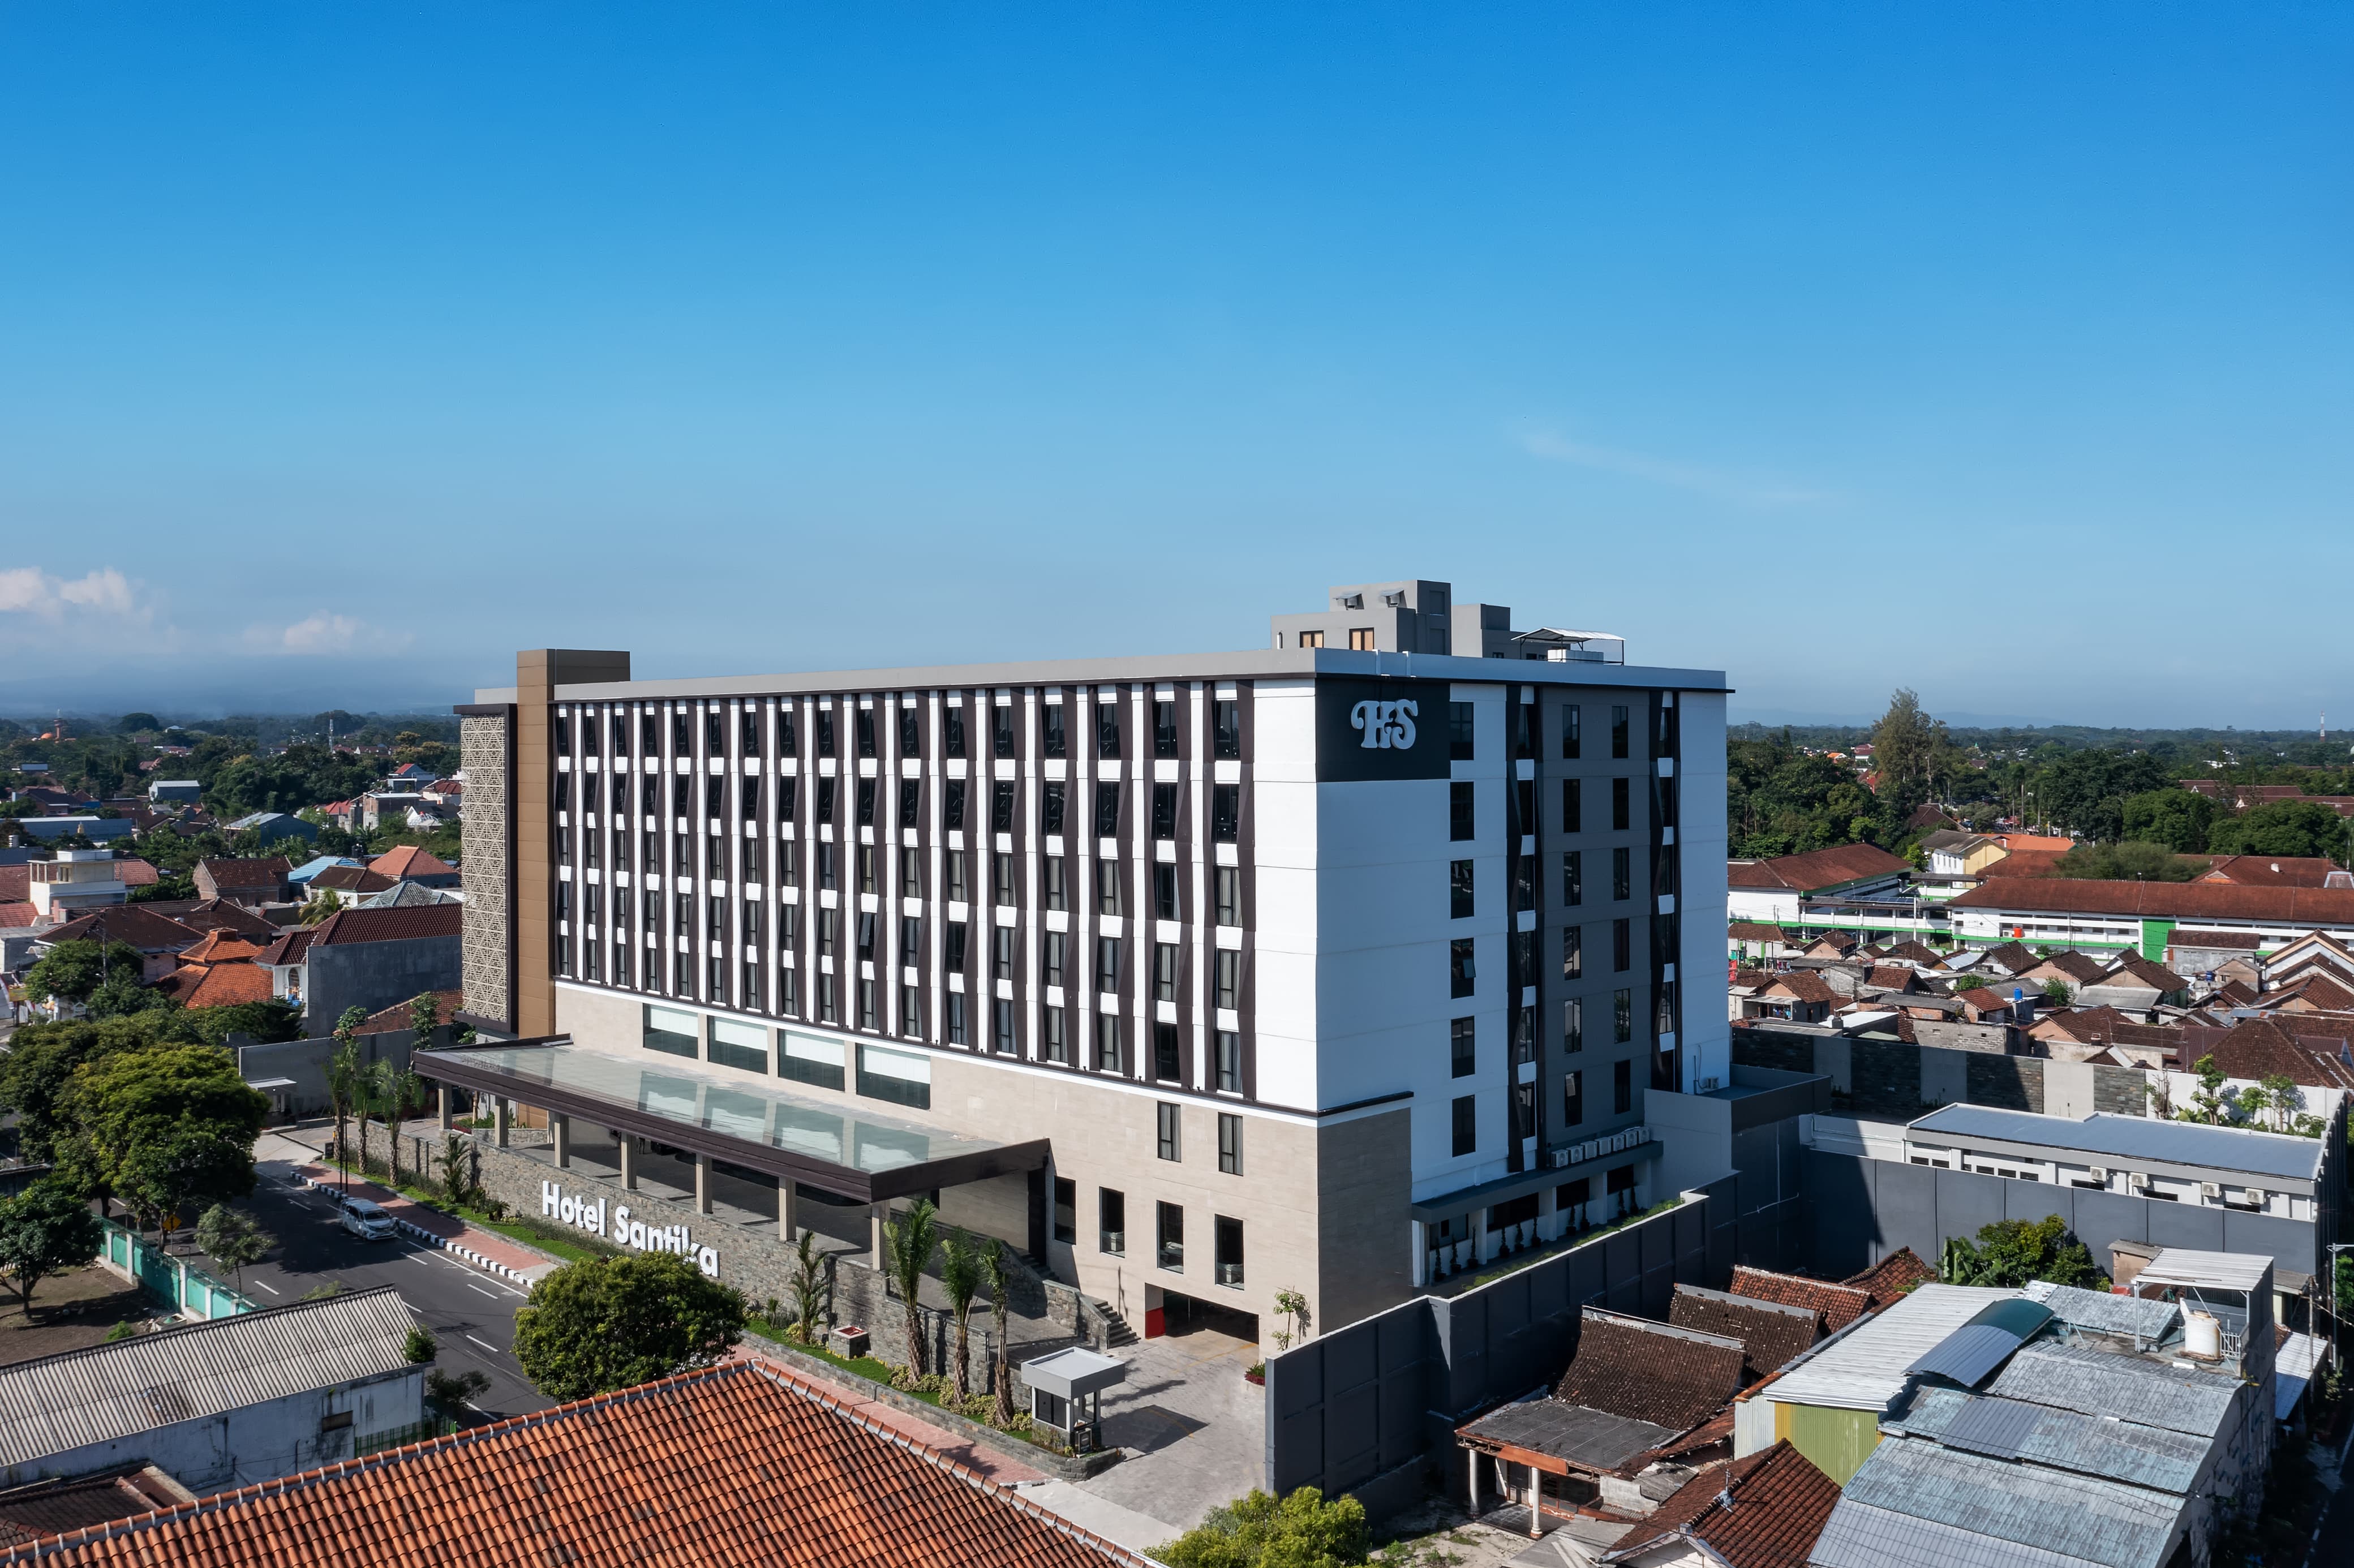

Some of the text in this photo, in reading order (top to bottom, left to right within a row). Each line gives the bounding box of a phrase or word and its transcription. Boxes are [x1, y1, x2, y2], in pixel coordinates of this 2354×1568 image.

[1351, 699, 1418, 749] HS
[542, 1180, 720, 1277] Hotel Santika
